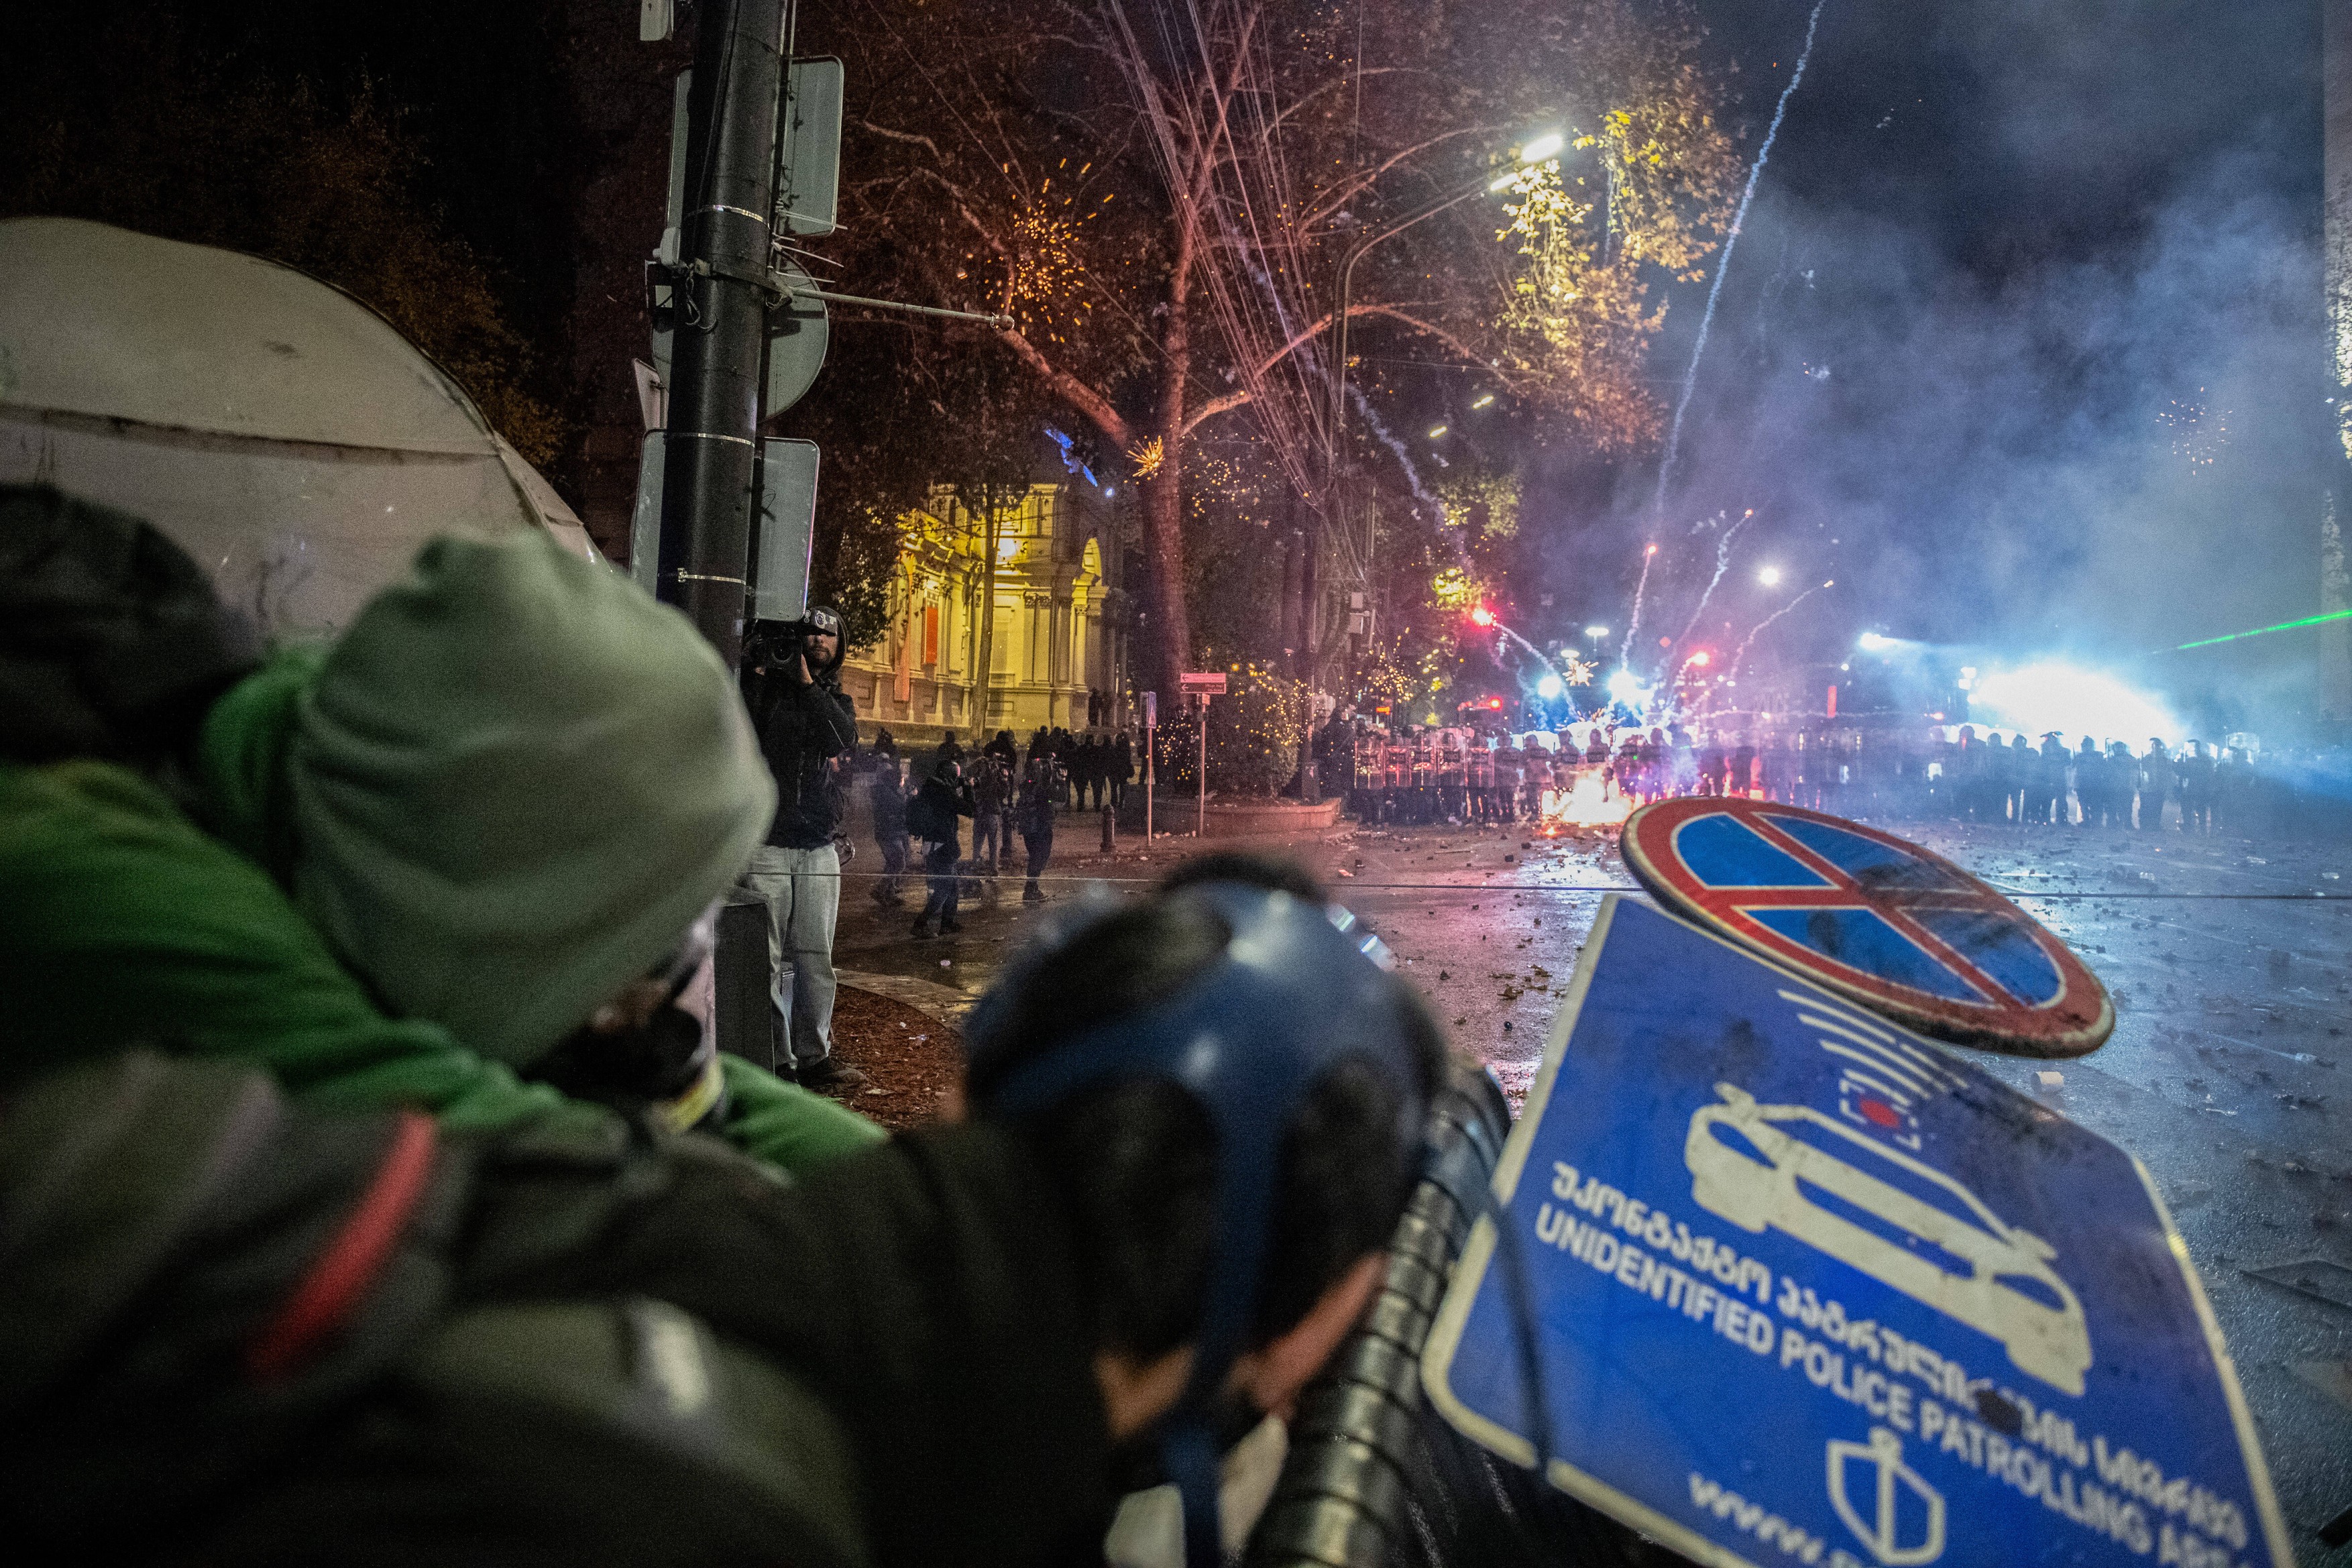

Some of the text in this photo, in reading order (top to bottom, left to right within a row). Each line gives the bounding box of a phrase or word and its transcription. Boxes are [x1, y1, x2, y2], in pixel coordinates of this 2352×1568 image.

[1535, 1203, 1774, 1354] UNIDENTIFIED
[1781, 1328, 1913, 1431] POLICE
[1920, 1400, 2151, 1555] PATROLLING
